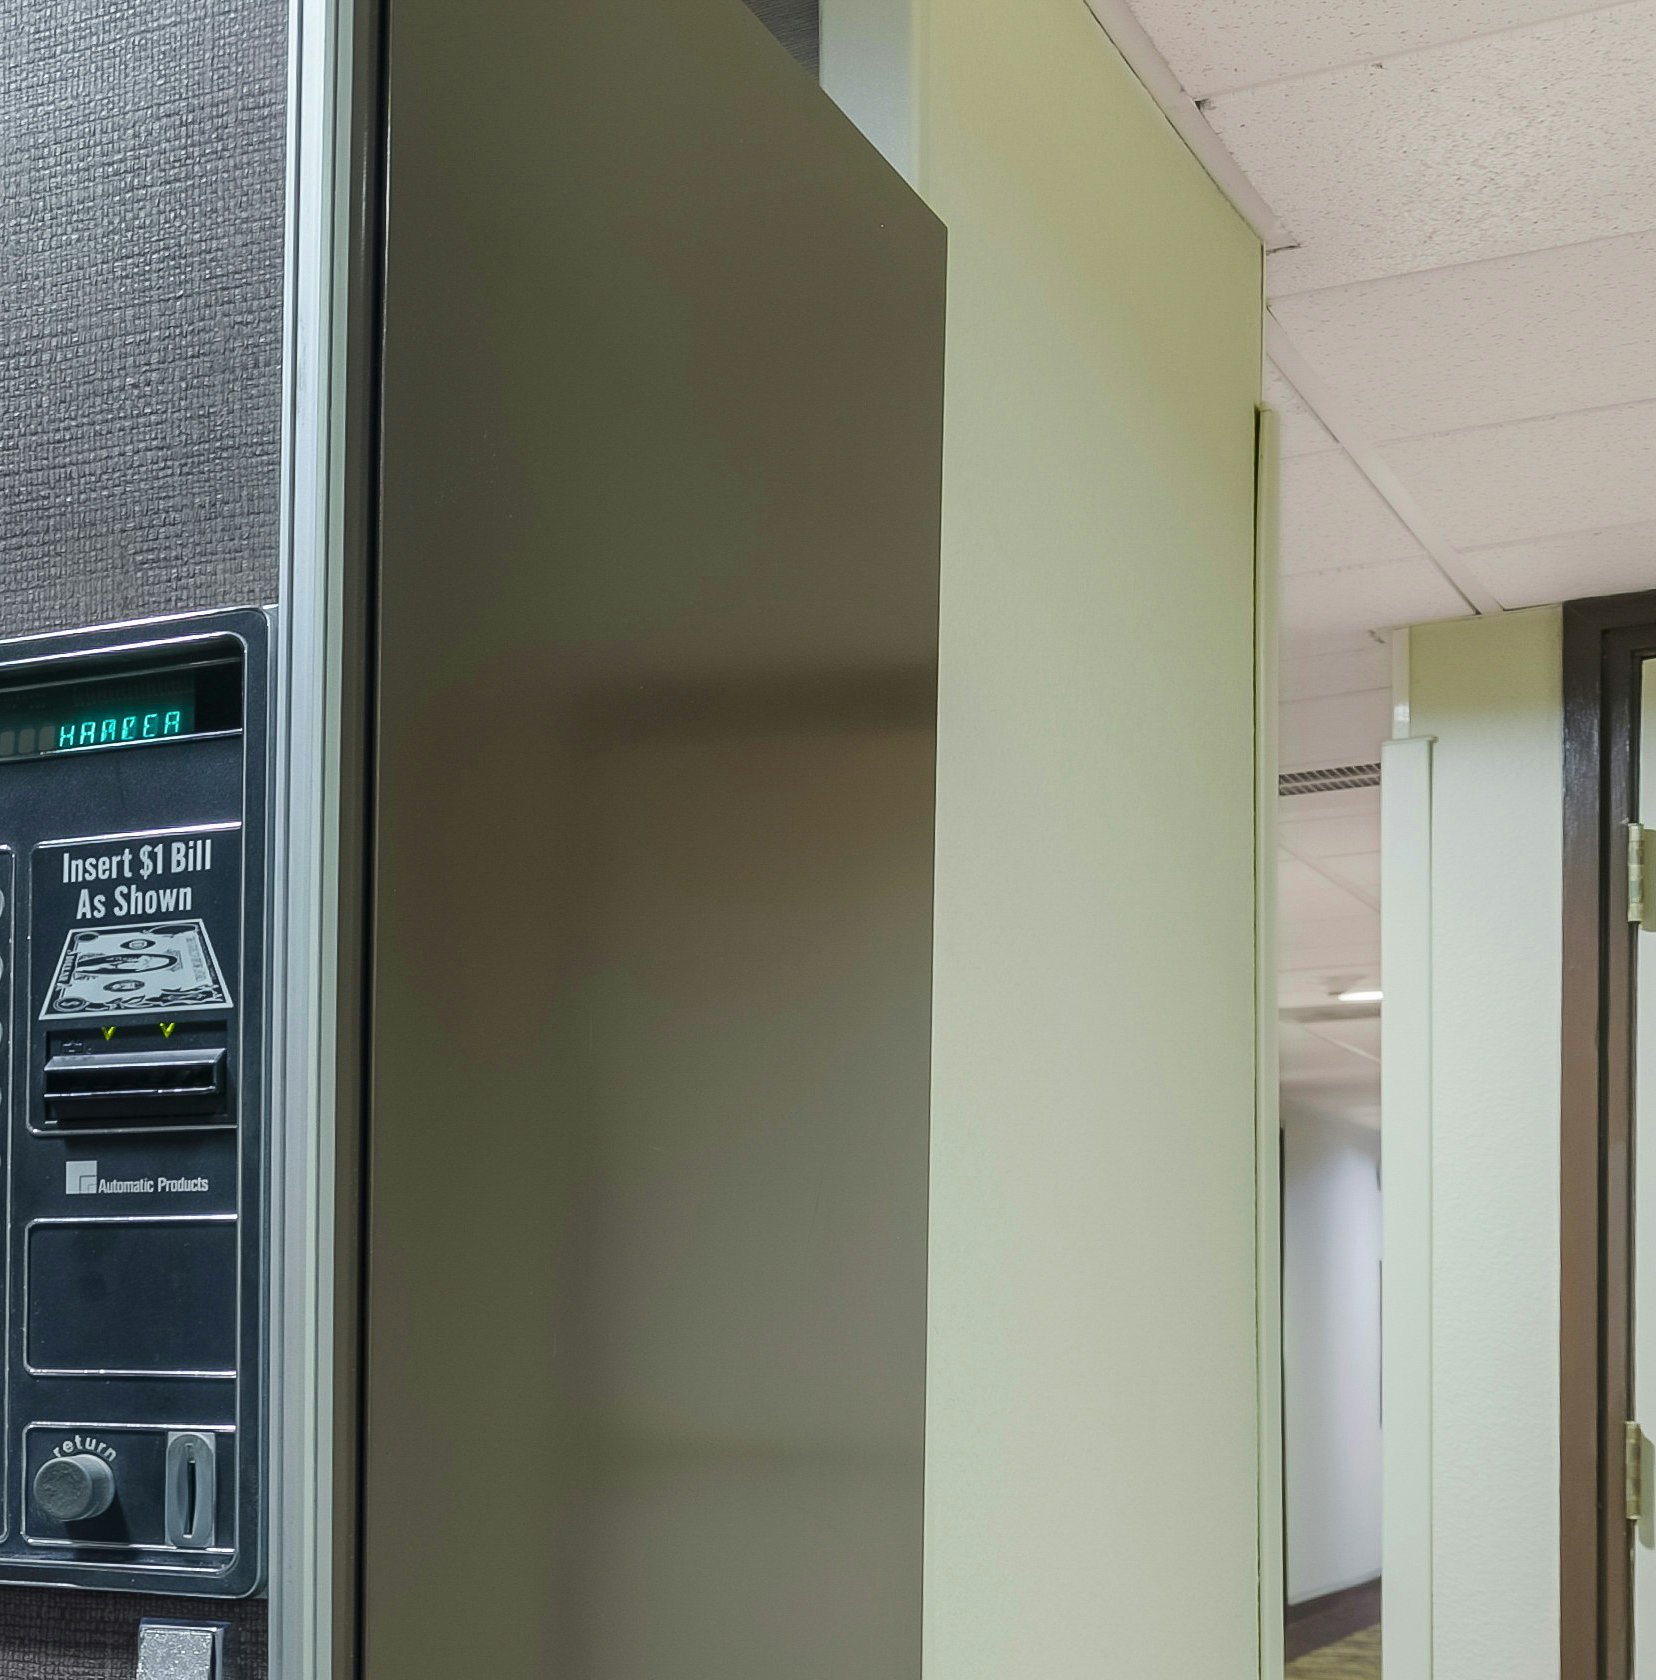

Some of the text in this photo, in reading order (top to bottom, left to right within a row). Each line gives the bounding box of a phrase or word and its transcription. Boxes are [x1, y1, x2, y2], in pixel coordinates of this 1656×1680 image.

[63, 839, 212, 884] Insert $1 Bill
[76, 884, 192, 920] As Shown
[98, 1176, 209, 1194] Automatic Products
[53, 1434, 117, 1462] return
